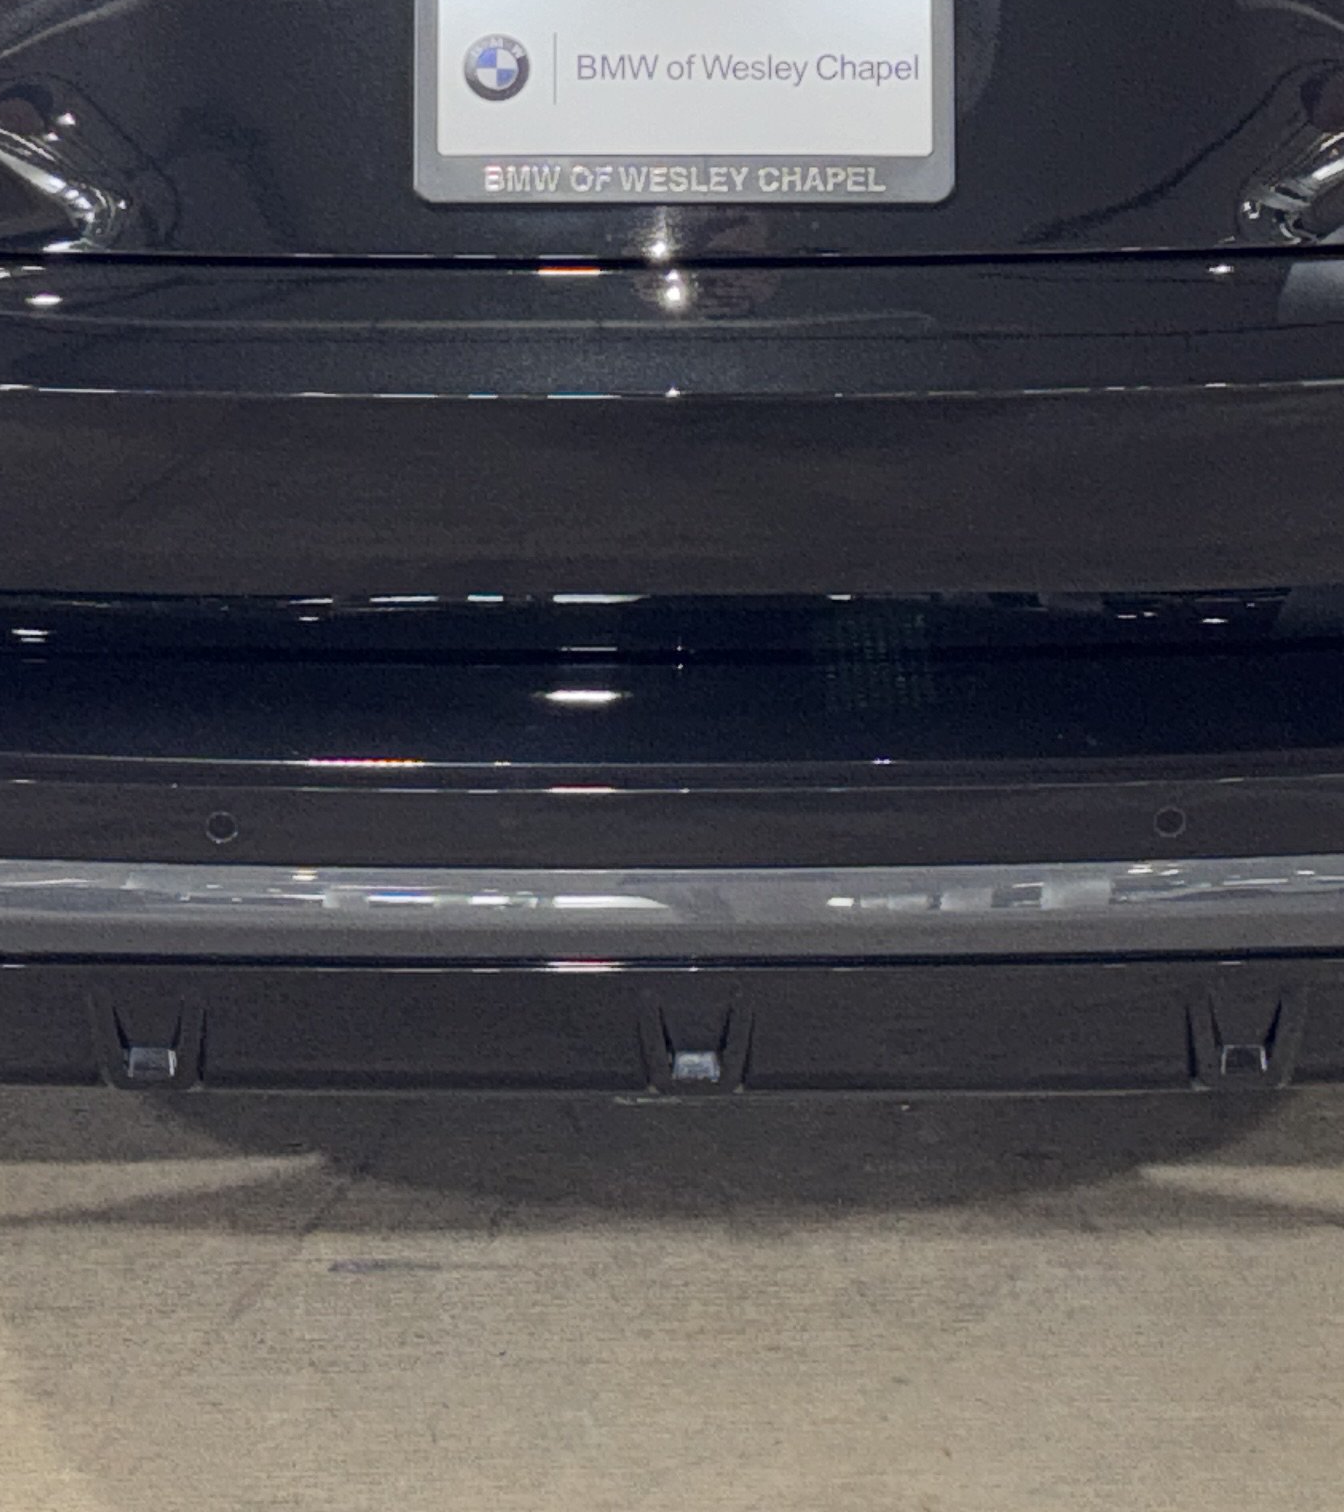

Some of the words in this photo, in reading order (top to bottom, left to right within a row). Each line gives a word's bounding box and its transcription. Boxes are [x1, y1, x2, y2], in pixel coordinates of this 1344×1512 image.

[576, 55, 659, 80] BMW
[667, 54, 697, 80] of
[702, 54, 808, 87] Wesley
[816, 54, 920, 87] Chapel
[484, 165, 560, 192] BMW
[570, 165, 612, 192] OF
[621, 165, 749, 192] WESLEY
[758, 165, 886, 192] CHAPEL
